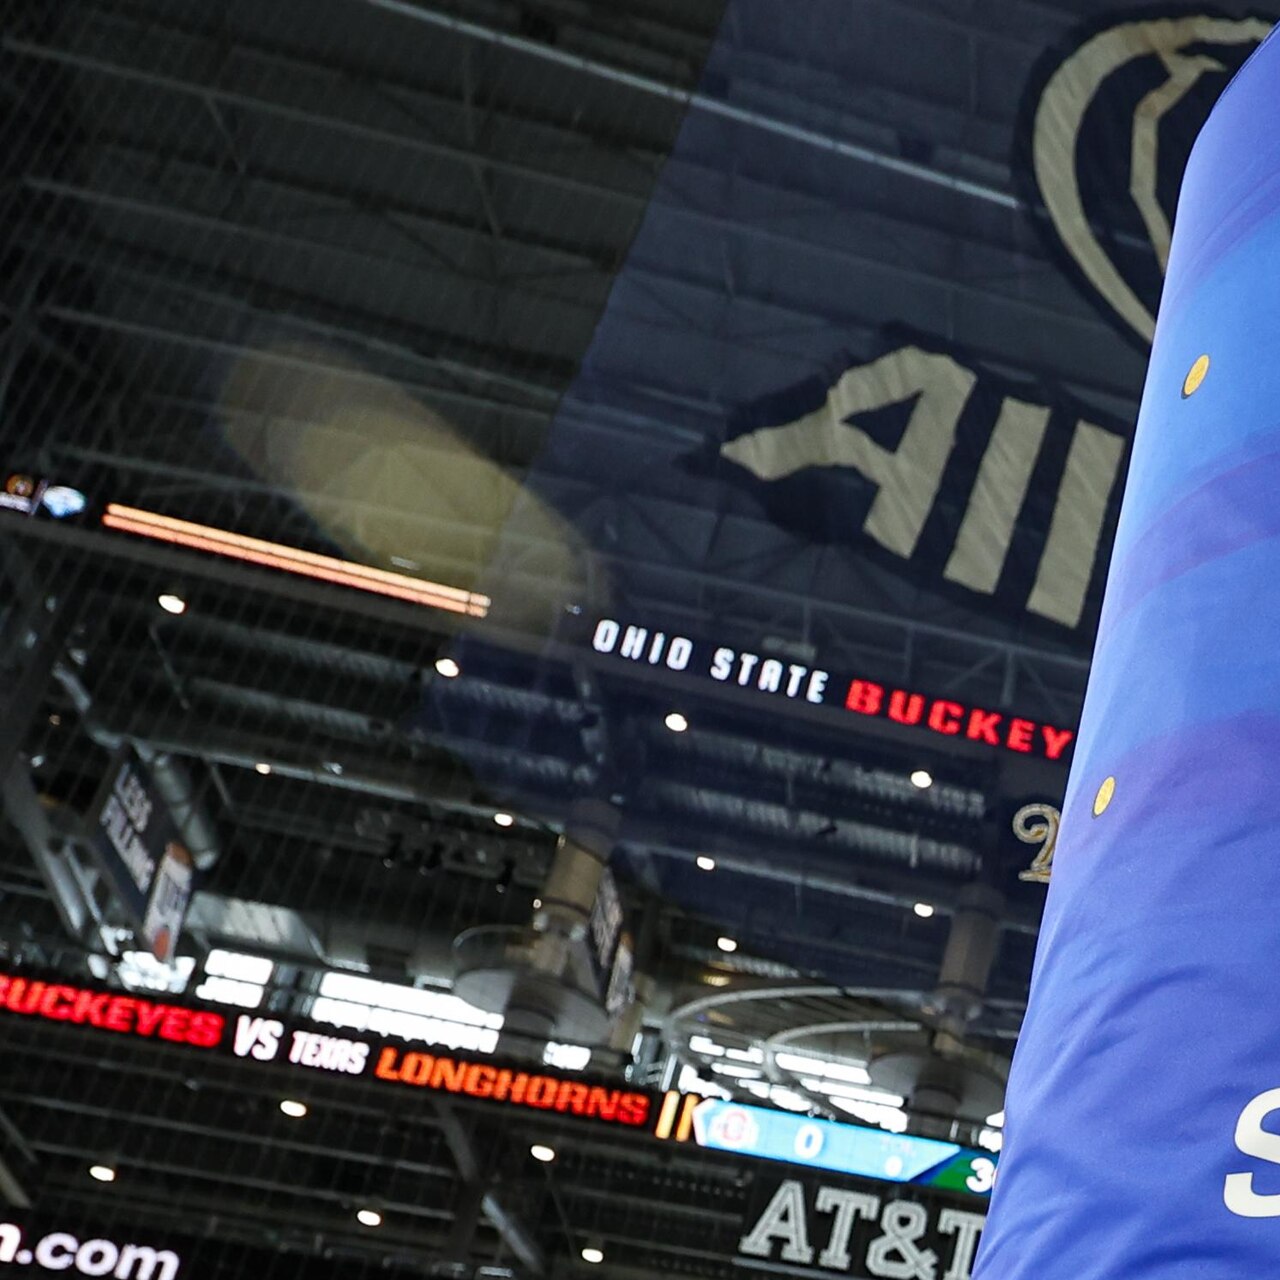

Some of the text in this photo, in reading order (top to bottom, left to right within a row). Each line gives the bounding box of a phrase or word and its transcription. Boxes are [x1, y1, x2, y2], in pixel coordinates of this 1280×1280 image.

[593, 619, 1074, 760] OHIO STATE BUCKEY
[233, 1014, 284, 1061] VS
[288, 1029, 370, 1075] TEXAS
[374, 1046, 651, 1126] LONGHORNS
[794, 1124, 824, 1159] 0
[965, 1156, 997, 1193] 3
